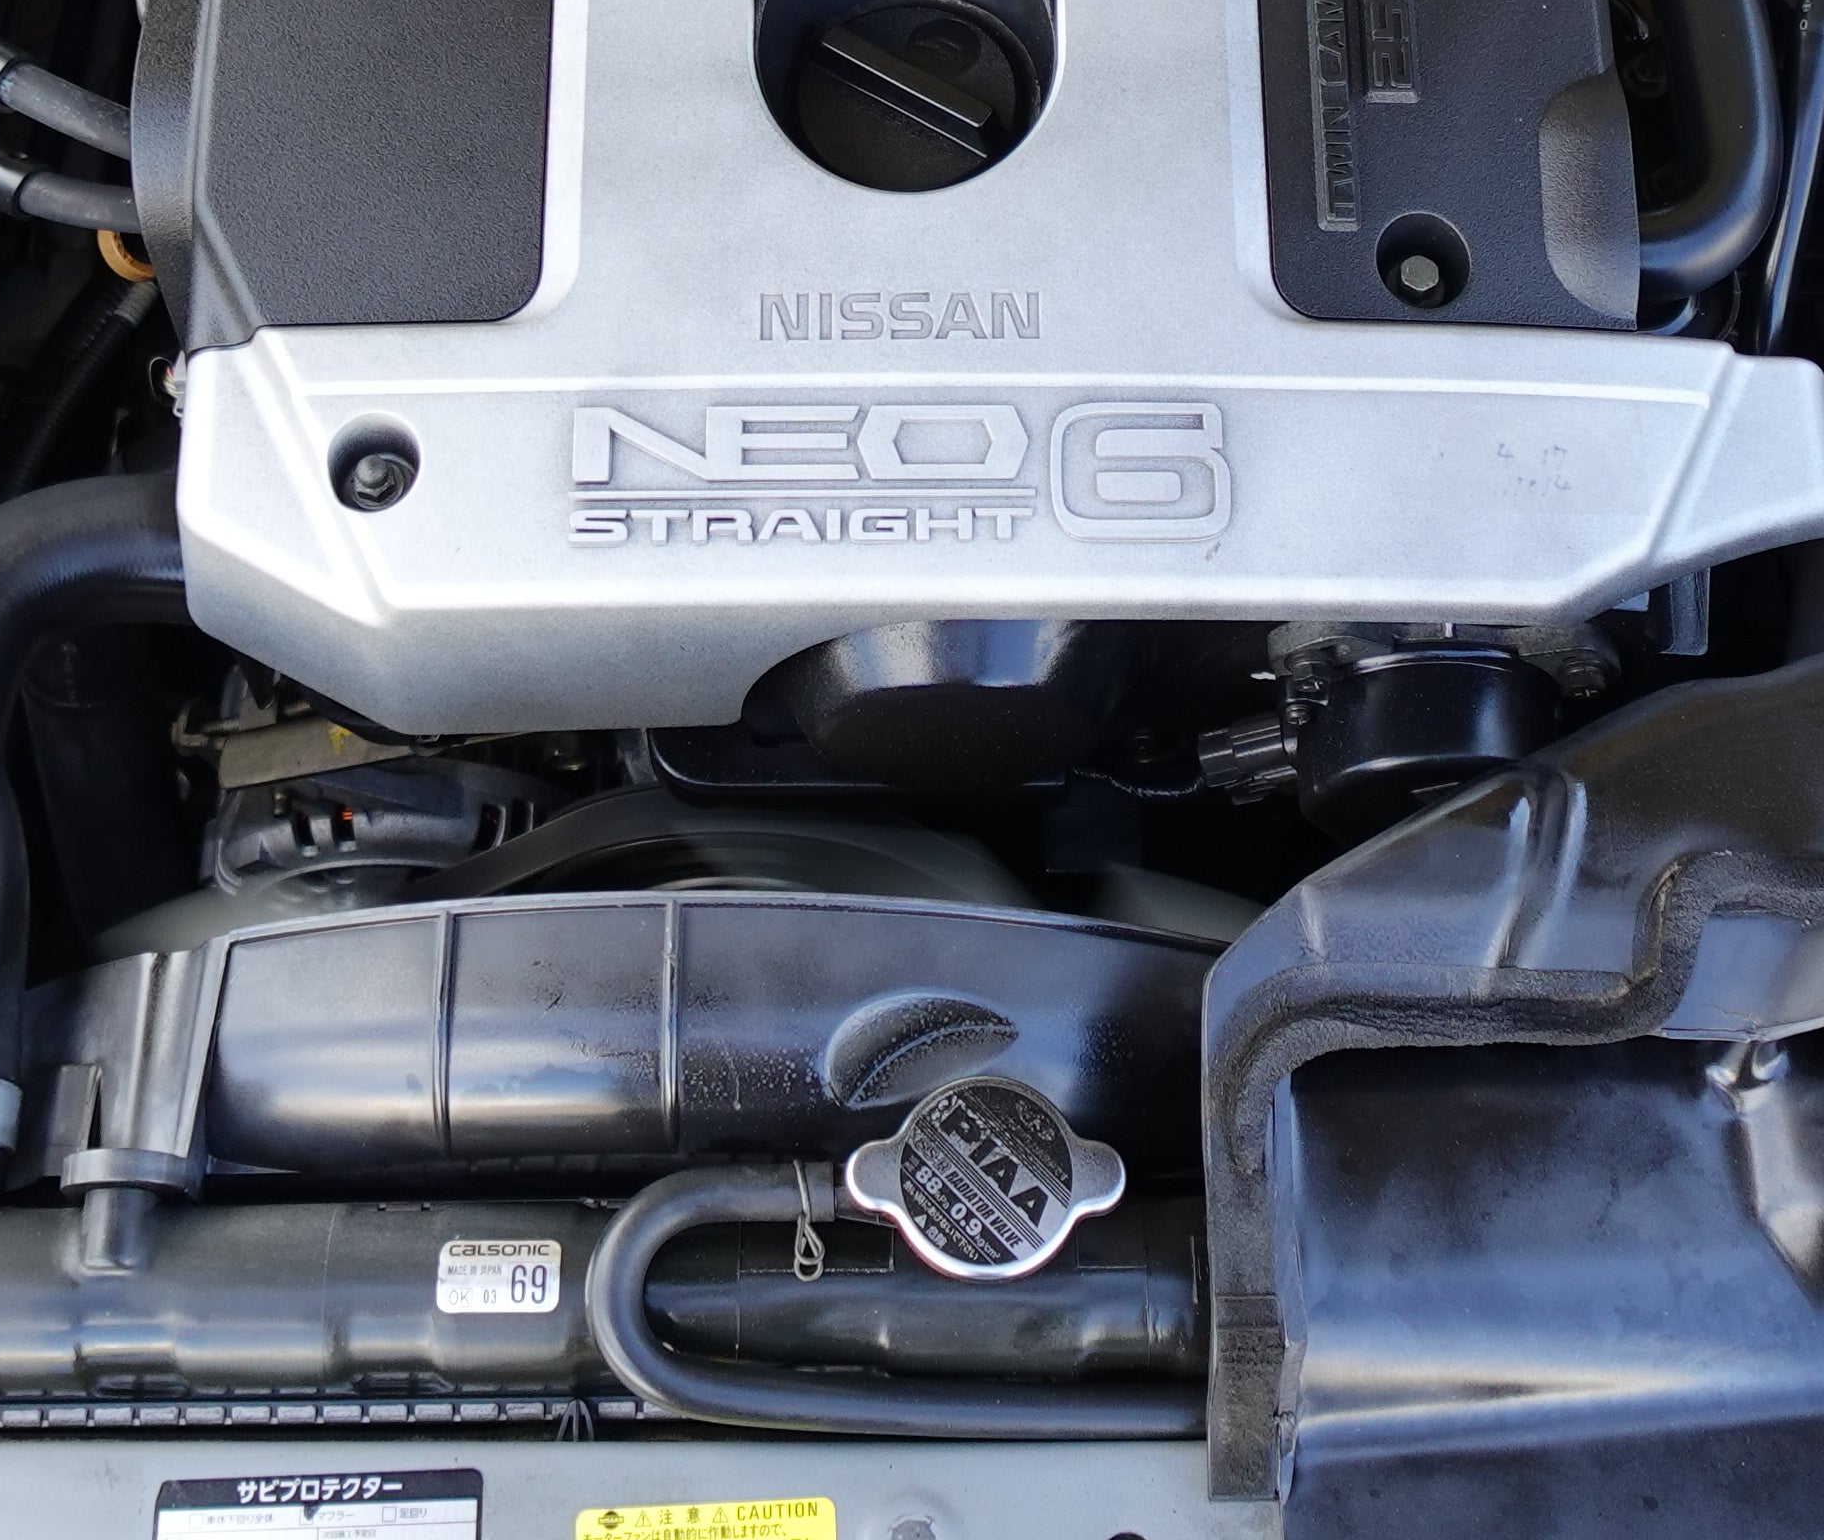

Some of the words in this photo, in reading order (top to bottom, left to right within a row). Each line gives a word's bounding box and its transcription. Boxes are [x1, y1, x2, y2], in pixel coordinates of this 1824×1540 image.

[1319, 103, 1358, 222] TWIN
[759, 291, 1041, 341] NISSAN
[572, 404, 1030, 485] NEO
[1049, 400, 1233, 544] 6
[567, 507, 1035, 546] STRAIGHT
[939, 1108, 1049, 1229] PIAA
[945, 1167, 998, 1220] RADIATOR
[989, 1210, 1025, 1248] VALVE
[447, 1265, 468, 1276] MADE
[470, 1265, 477, 1276] IN
[479, 1265, 503, 1276] JAPAN
[511, 1264, 548, 1304] 69
[448, 1289, 471, 1306] OK
[483, 1289, 497, 1304] 03
[237, 1476, 403, 1504] サビプロテクター
[317, 1511, 355, 1523] マフラー
[399, 1507, 428, 1520] 足回り
[659, 1506, 701, 1526] 注意
[737, 1501, 818, 1522] CAUTION
